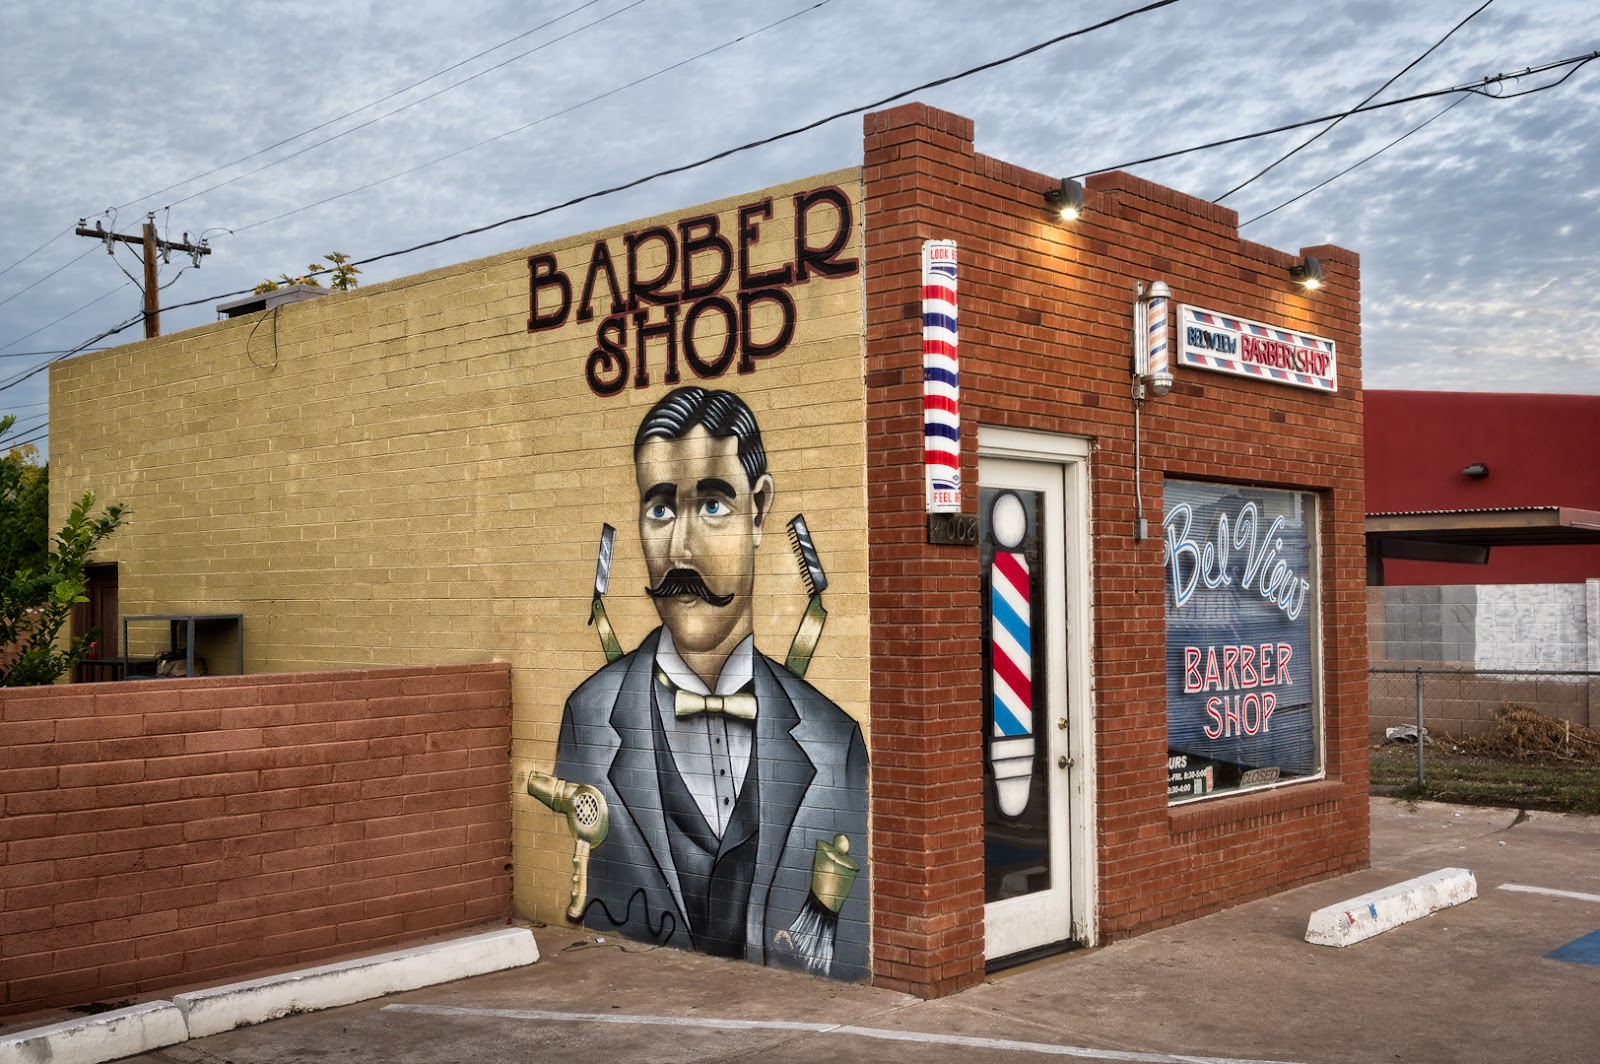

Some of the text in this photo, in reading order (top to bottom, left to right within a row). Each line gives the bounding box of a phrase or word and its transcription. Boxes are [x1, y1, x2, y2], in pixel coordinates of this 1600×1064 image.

[527, 185, 860, 334] BARBER
[930, 249, 949, 260] LOOK
[585, 285, 797, 397] SHOP
[1187, 326, 1237, 355] BEL VIEW
[1241, 334, 1330, 377] BARBER SHOP
[933, 491, 952, 503] FEEL
[1163, 501, 1310, 621] Bel View
[1184, 643, 1293, 694] BARBER
[1203, 692, 1277, 739] SHOP
[1167, 755, 1187, 770] URS
[1242, 769, 1279, 786] CLOSED
